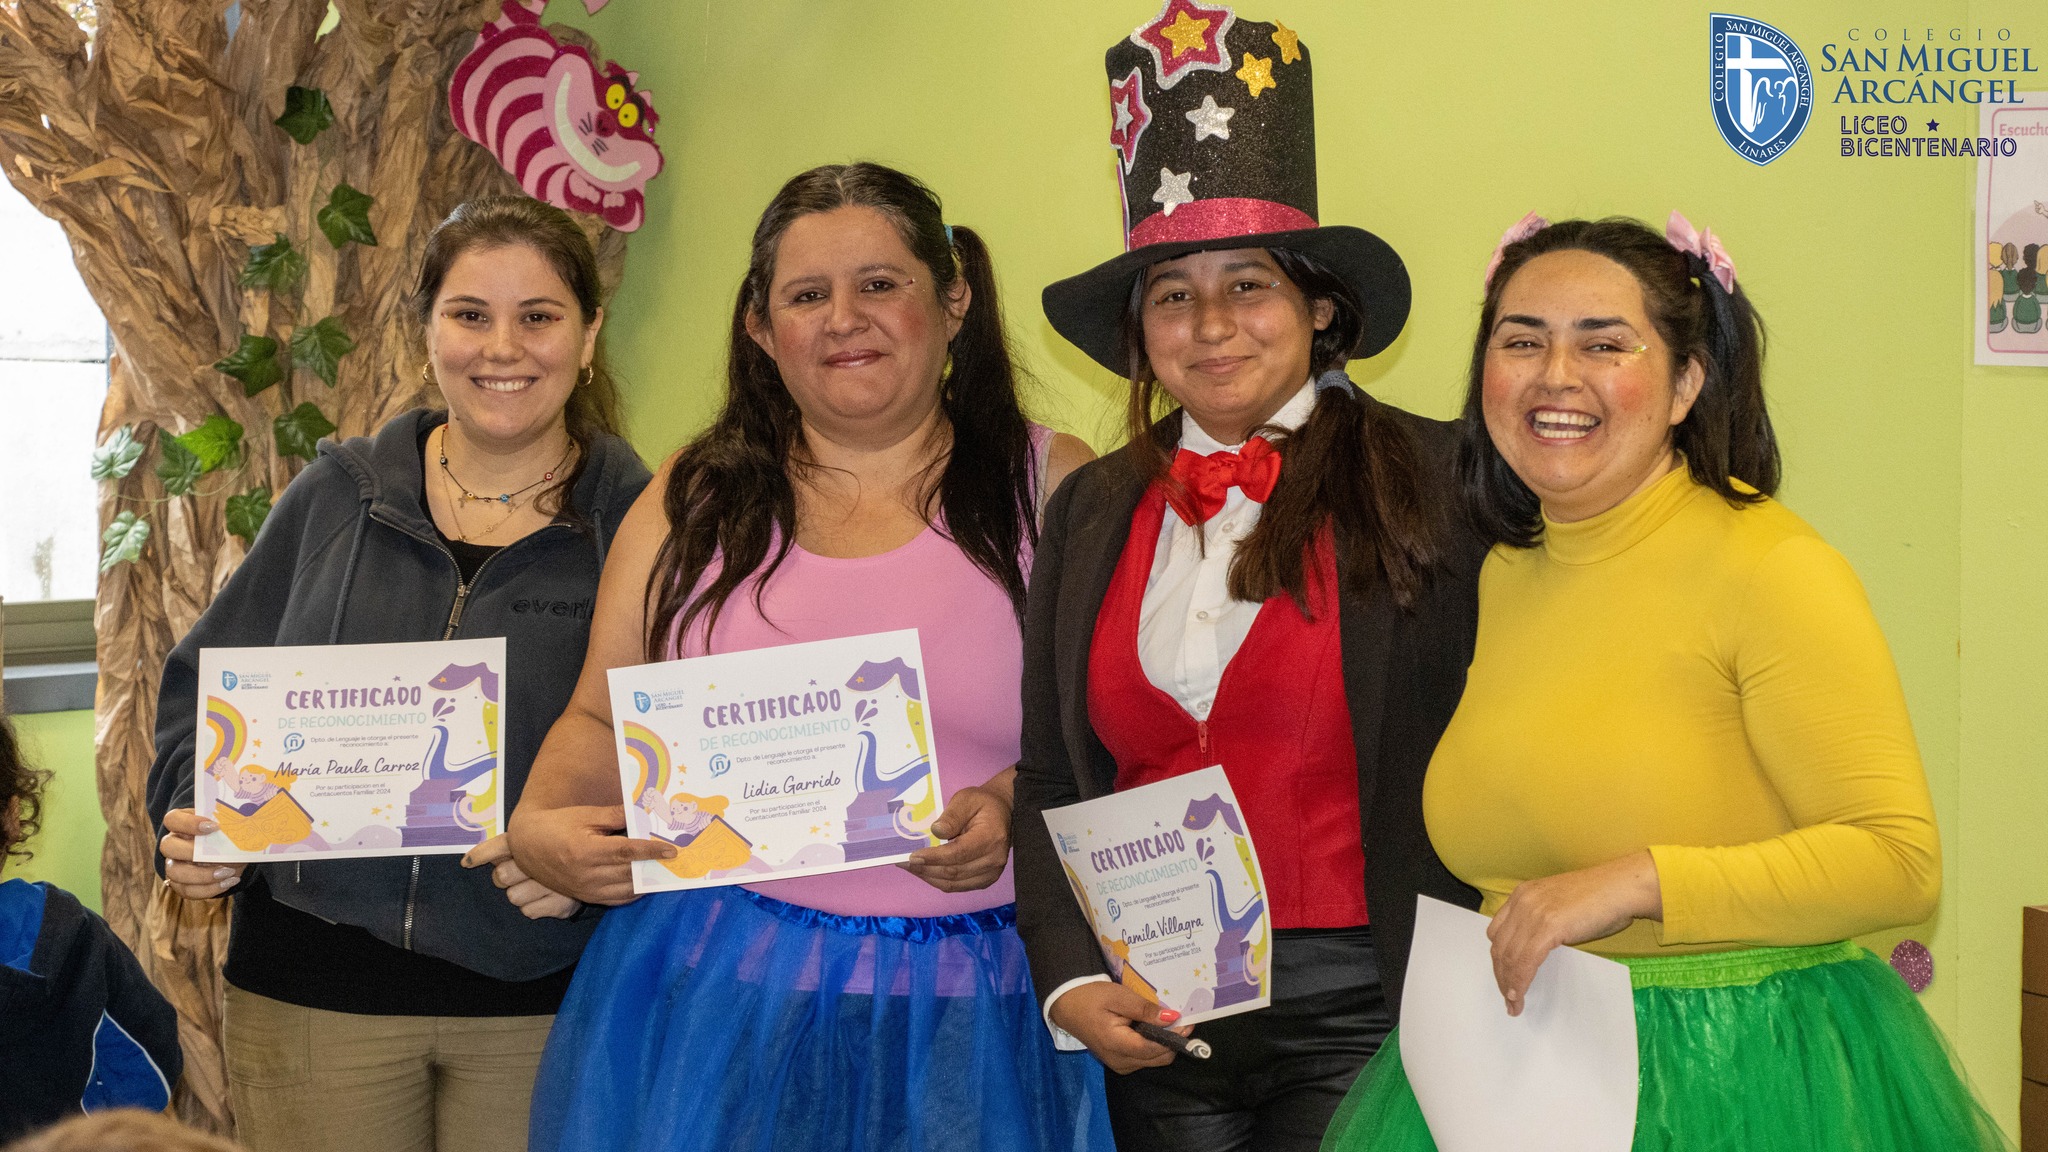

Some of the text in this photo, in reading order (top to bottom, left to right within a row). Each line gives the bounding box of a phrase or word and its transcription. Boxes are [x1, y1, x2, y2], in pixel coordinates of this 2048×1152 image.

[285, 686, 422, 710] CERTIFICADO
[703, 688, 841, 728] CERTIFICADO
[278, 712, 427, 730] DE RECONOCIMIENTO
[700, 718, 851, 751] DE RECONOCIMIENTO
[820, 743, 846, 752] presente
[274, 758, 420, 778] María Paula Carroz
[767, 756, 811, 765] reconocimiento
[743, 770, 841, 799] Lidia Garrido
[745, 812, 788, 822] Cuentacuentos
[1091, 830, 1185, 874] CERTIFICADO
[1096, 858, 1198, 896] DE RECONOCIMIENTO
[1122, 916, 1204, 946] Camila Villagra
